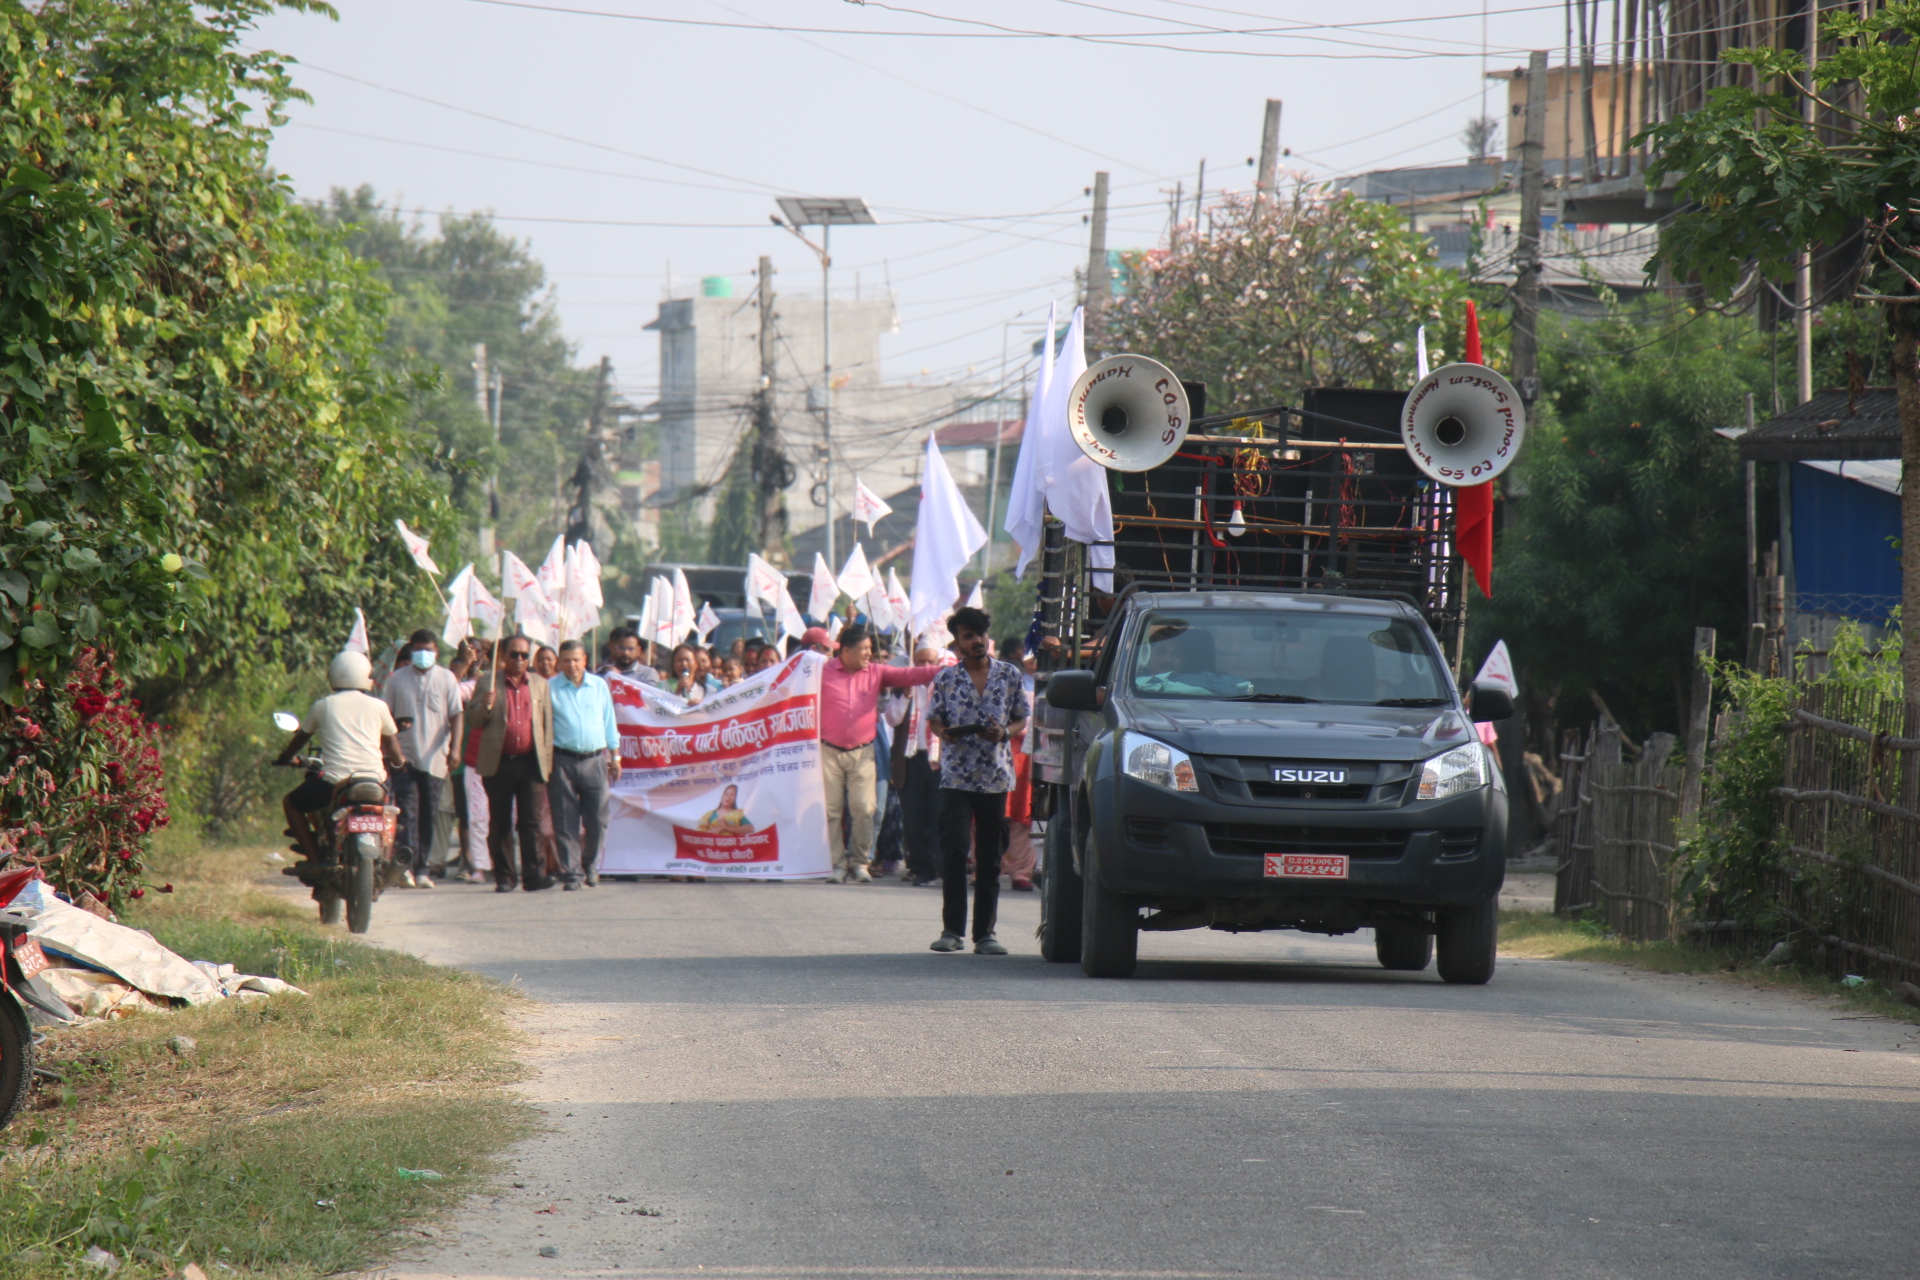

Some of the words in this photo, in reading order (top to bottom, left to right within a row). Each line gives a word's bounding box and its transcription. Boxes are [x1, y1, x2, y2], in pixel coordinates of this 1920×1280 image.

[1077, 365, 1134, 425] Hanuman
[1448, 375, 1509, 403] System
[1471, 460, 1493, 477] DJ
[739, 685, 765, 699] पटक
[694, 724, 720, 753] पार्टी
[777, 761, 799, 773] विजय
[1275, 769, 1345, 783] ISUZU
